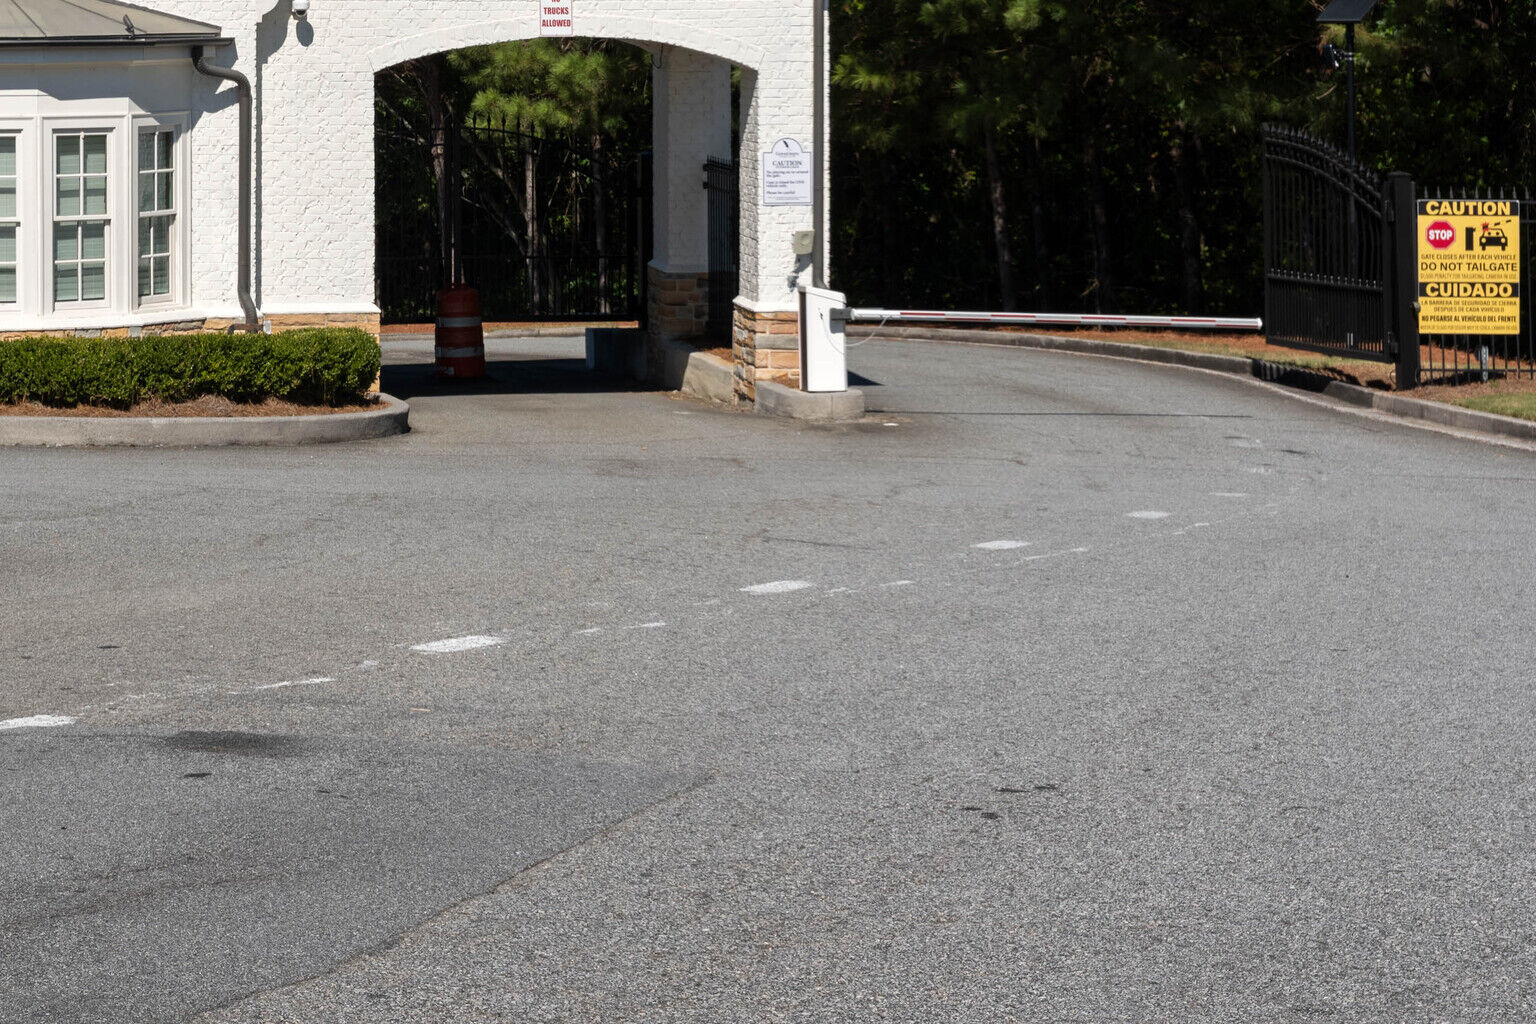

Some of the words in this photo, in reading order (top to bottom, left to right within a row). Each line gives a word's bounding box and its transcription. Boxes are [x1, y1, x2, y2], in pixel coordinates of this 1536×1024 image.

[544, 7, 569, 15] TRUCKS
[542, 19, 571, 27] ALLOWED
[1426, 201, 1511, 215] CAUTION
[1428, 229, 1453, 240] STOP
[1420, 262, 1437, 271] DO
[1440, 262, 1463, 271] NOT
[1466, 262, 1518, 271] TAILGATE
[1426, 283, 1512, 297] CUIDADO
